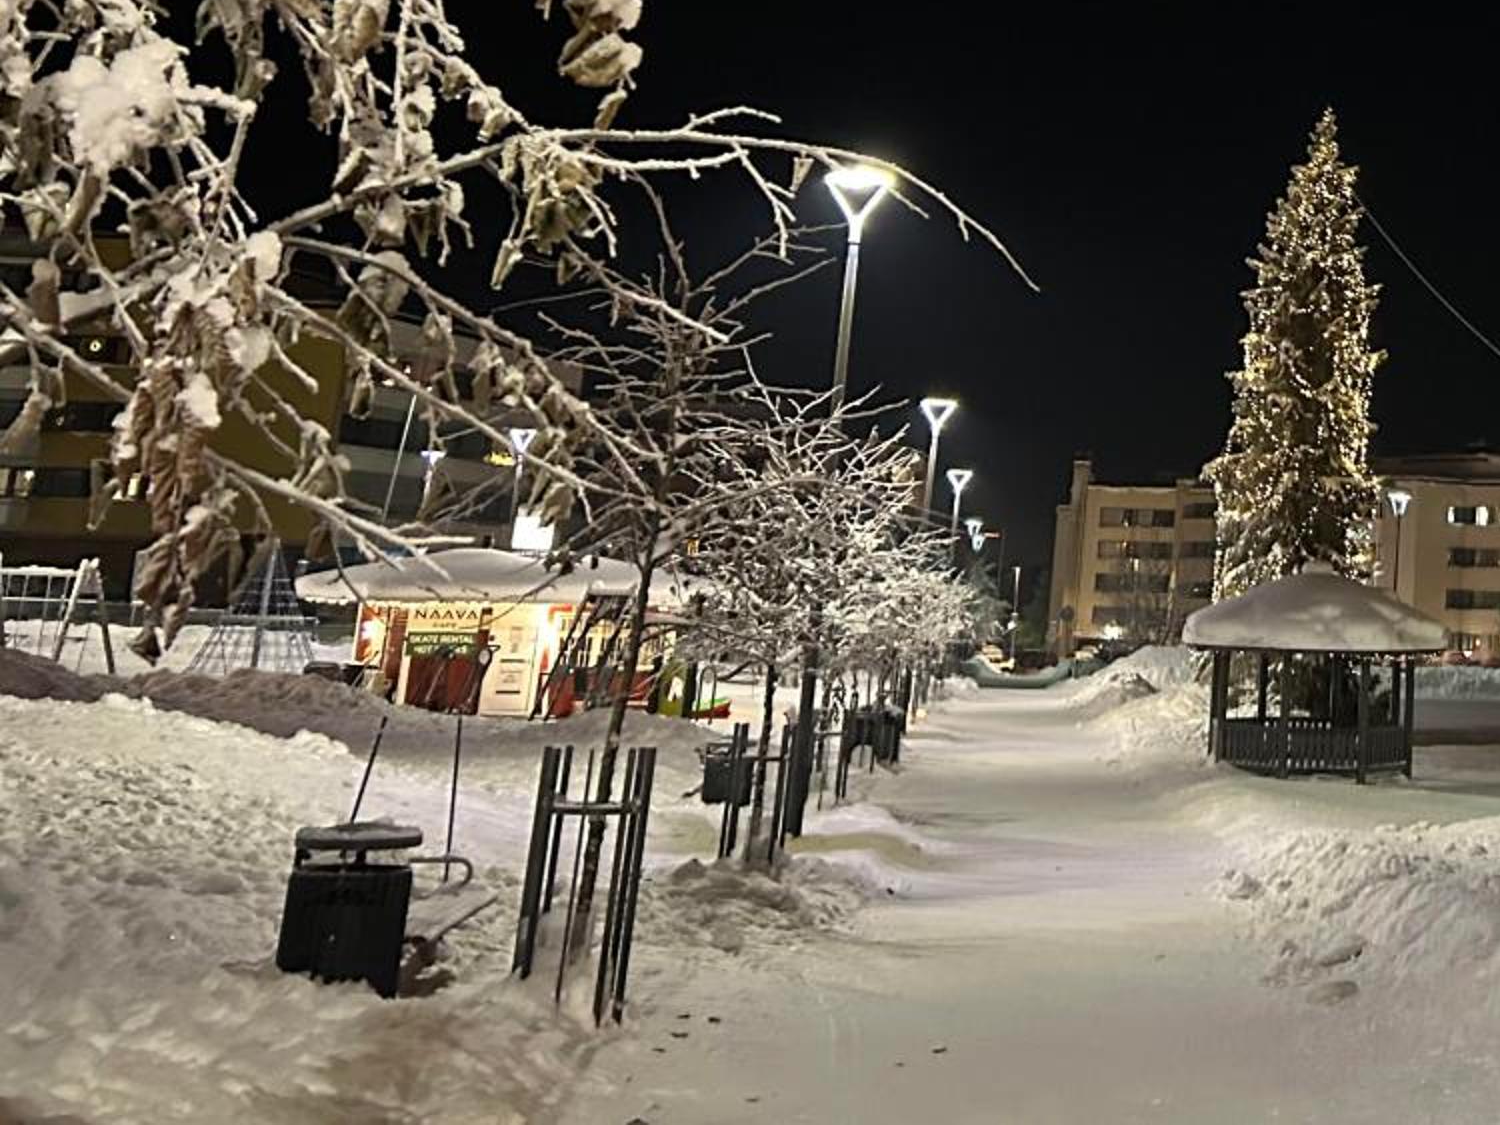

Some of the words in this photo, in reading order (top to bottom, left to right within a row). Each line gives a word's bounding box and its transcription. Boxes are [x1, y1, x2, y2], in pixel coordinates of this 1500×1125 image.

[414, 609, 478, 620] NAAVA
[409, 634, 439, 644] SKATE
[440, 634, 474, 644] RENTAL
